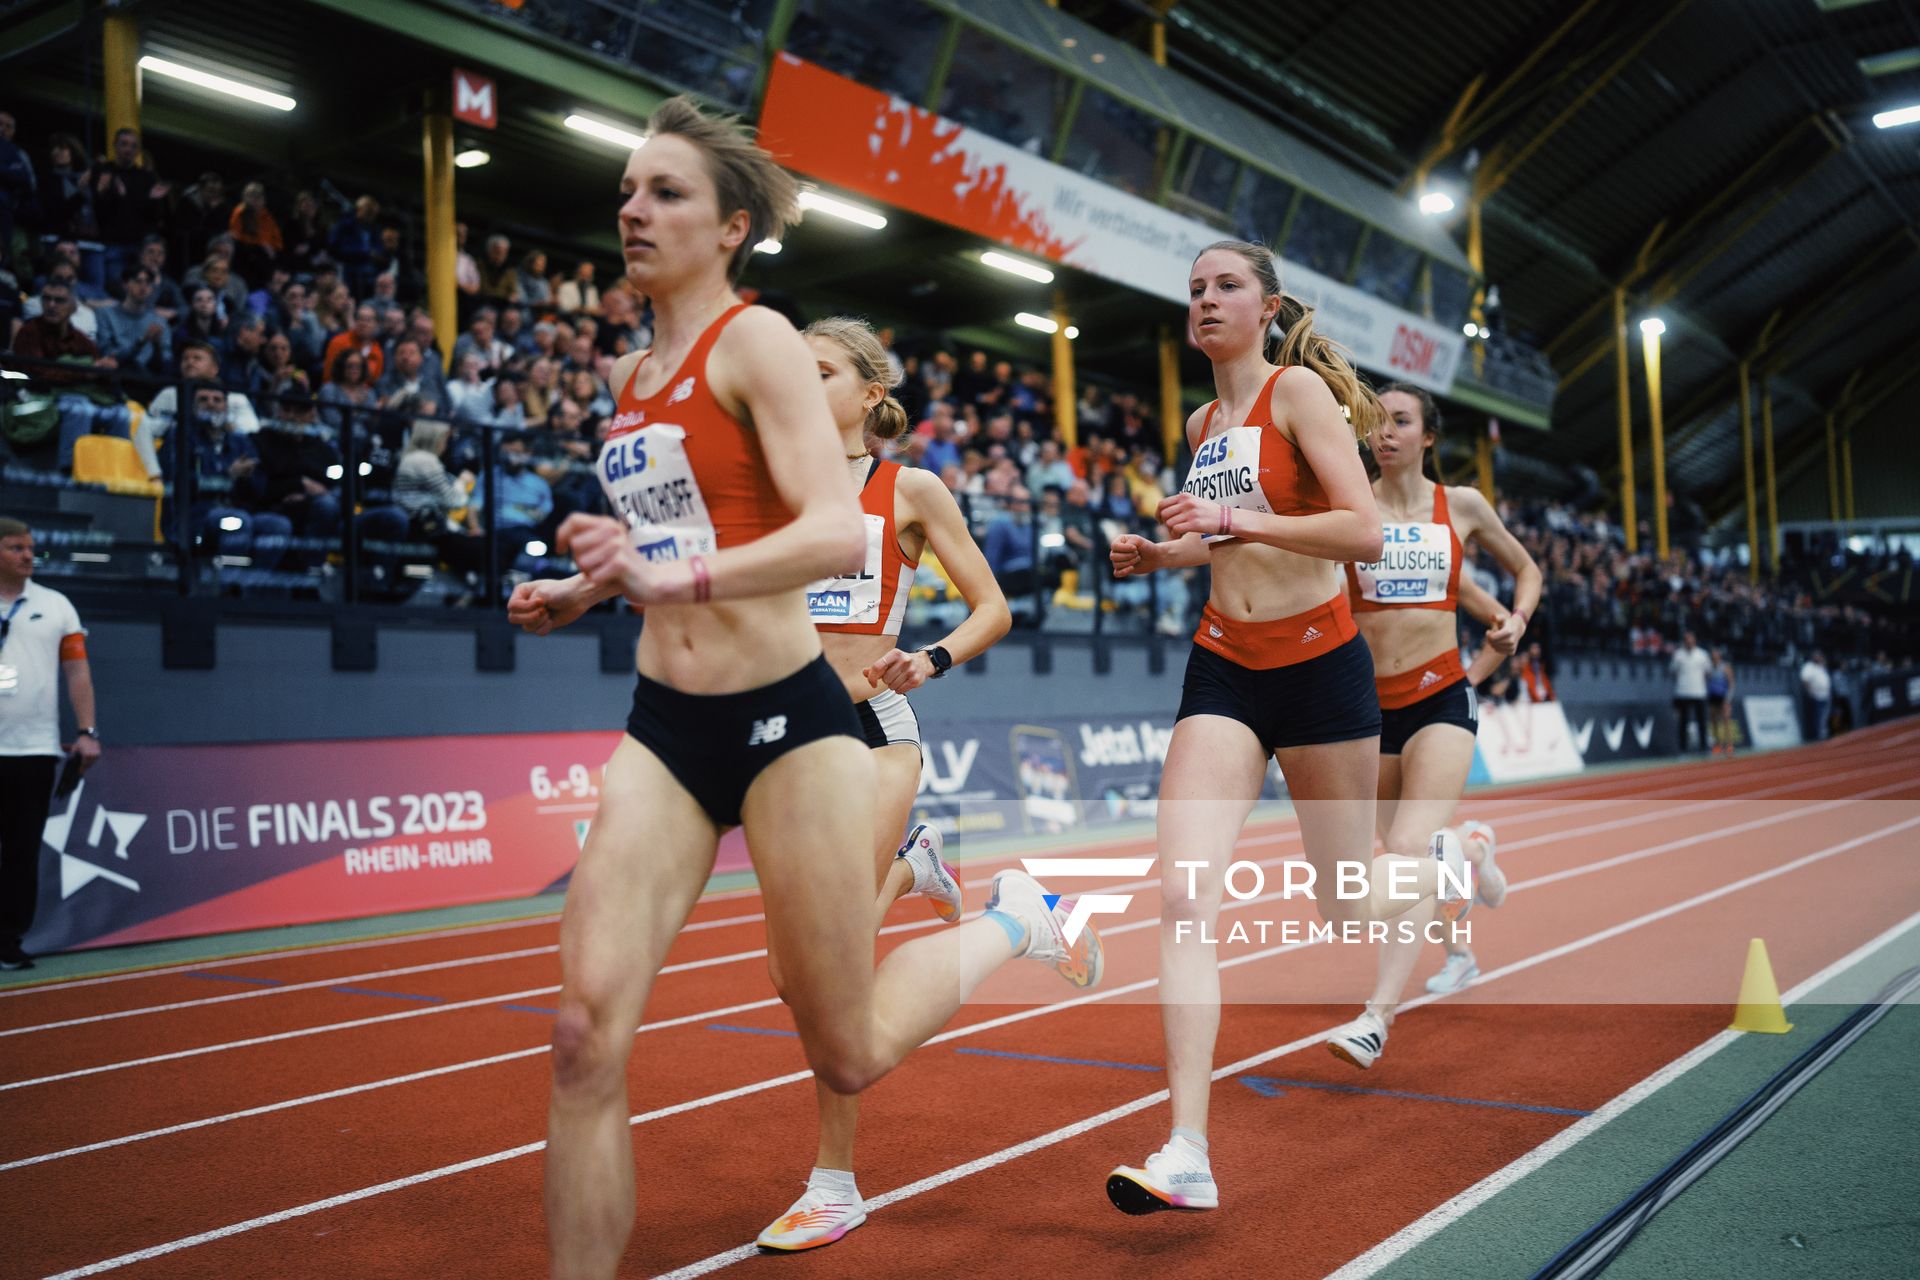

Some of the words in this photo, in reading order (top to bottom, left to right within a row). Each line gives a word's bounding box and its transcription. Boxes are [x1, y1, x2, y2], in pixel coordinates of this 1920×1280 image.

[458, 75, 492, 120] M
[809, 595, 848, 607] PLAN
[1396, 581, 1426, 591] PLAN
[166, 806, 239, 854] DIE
[248, 798, 397, 848] FINALS
[398, 790, 488, 835] 2023
[343, 837, 494, 876] RHEIN-RUHR
